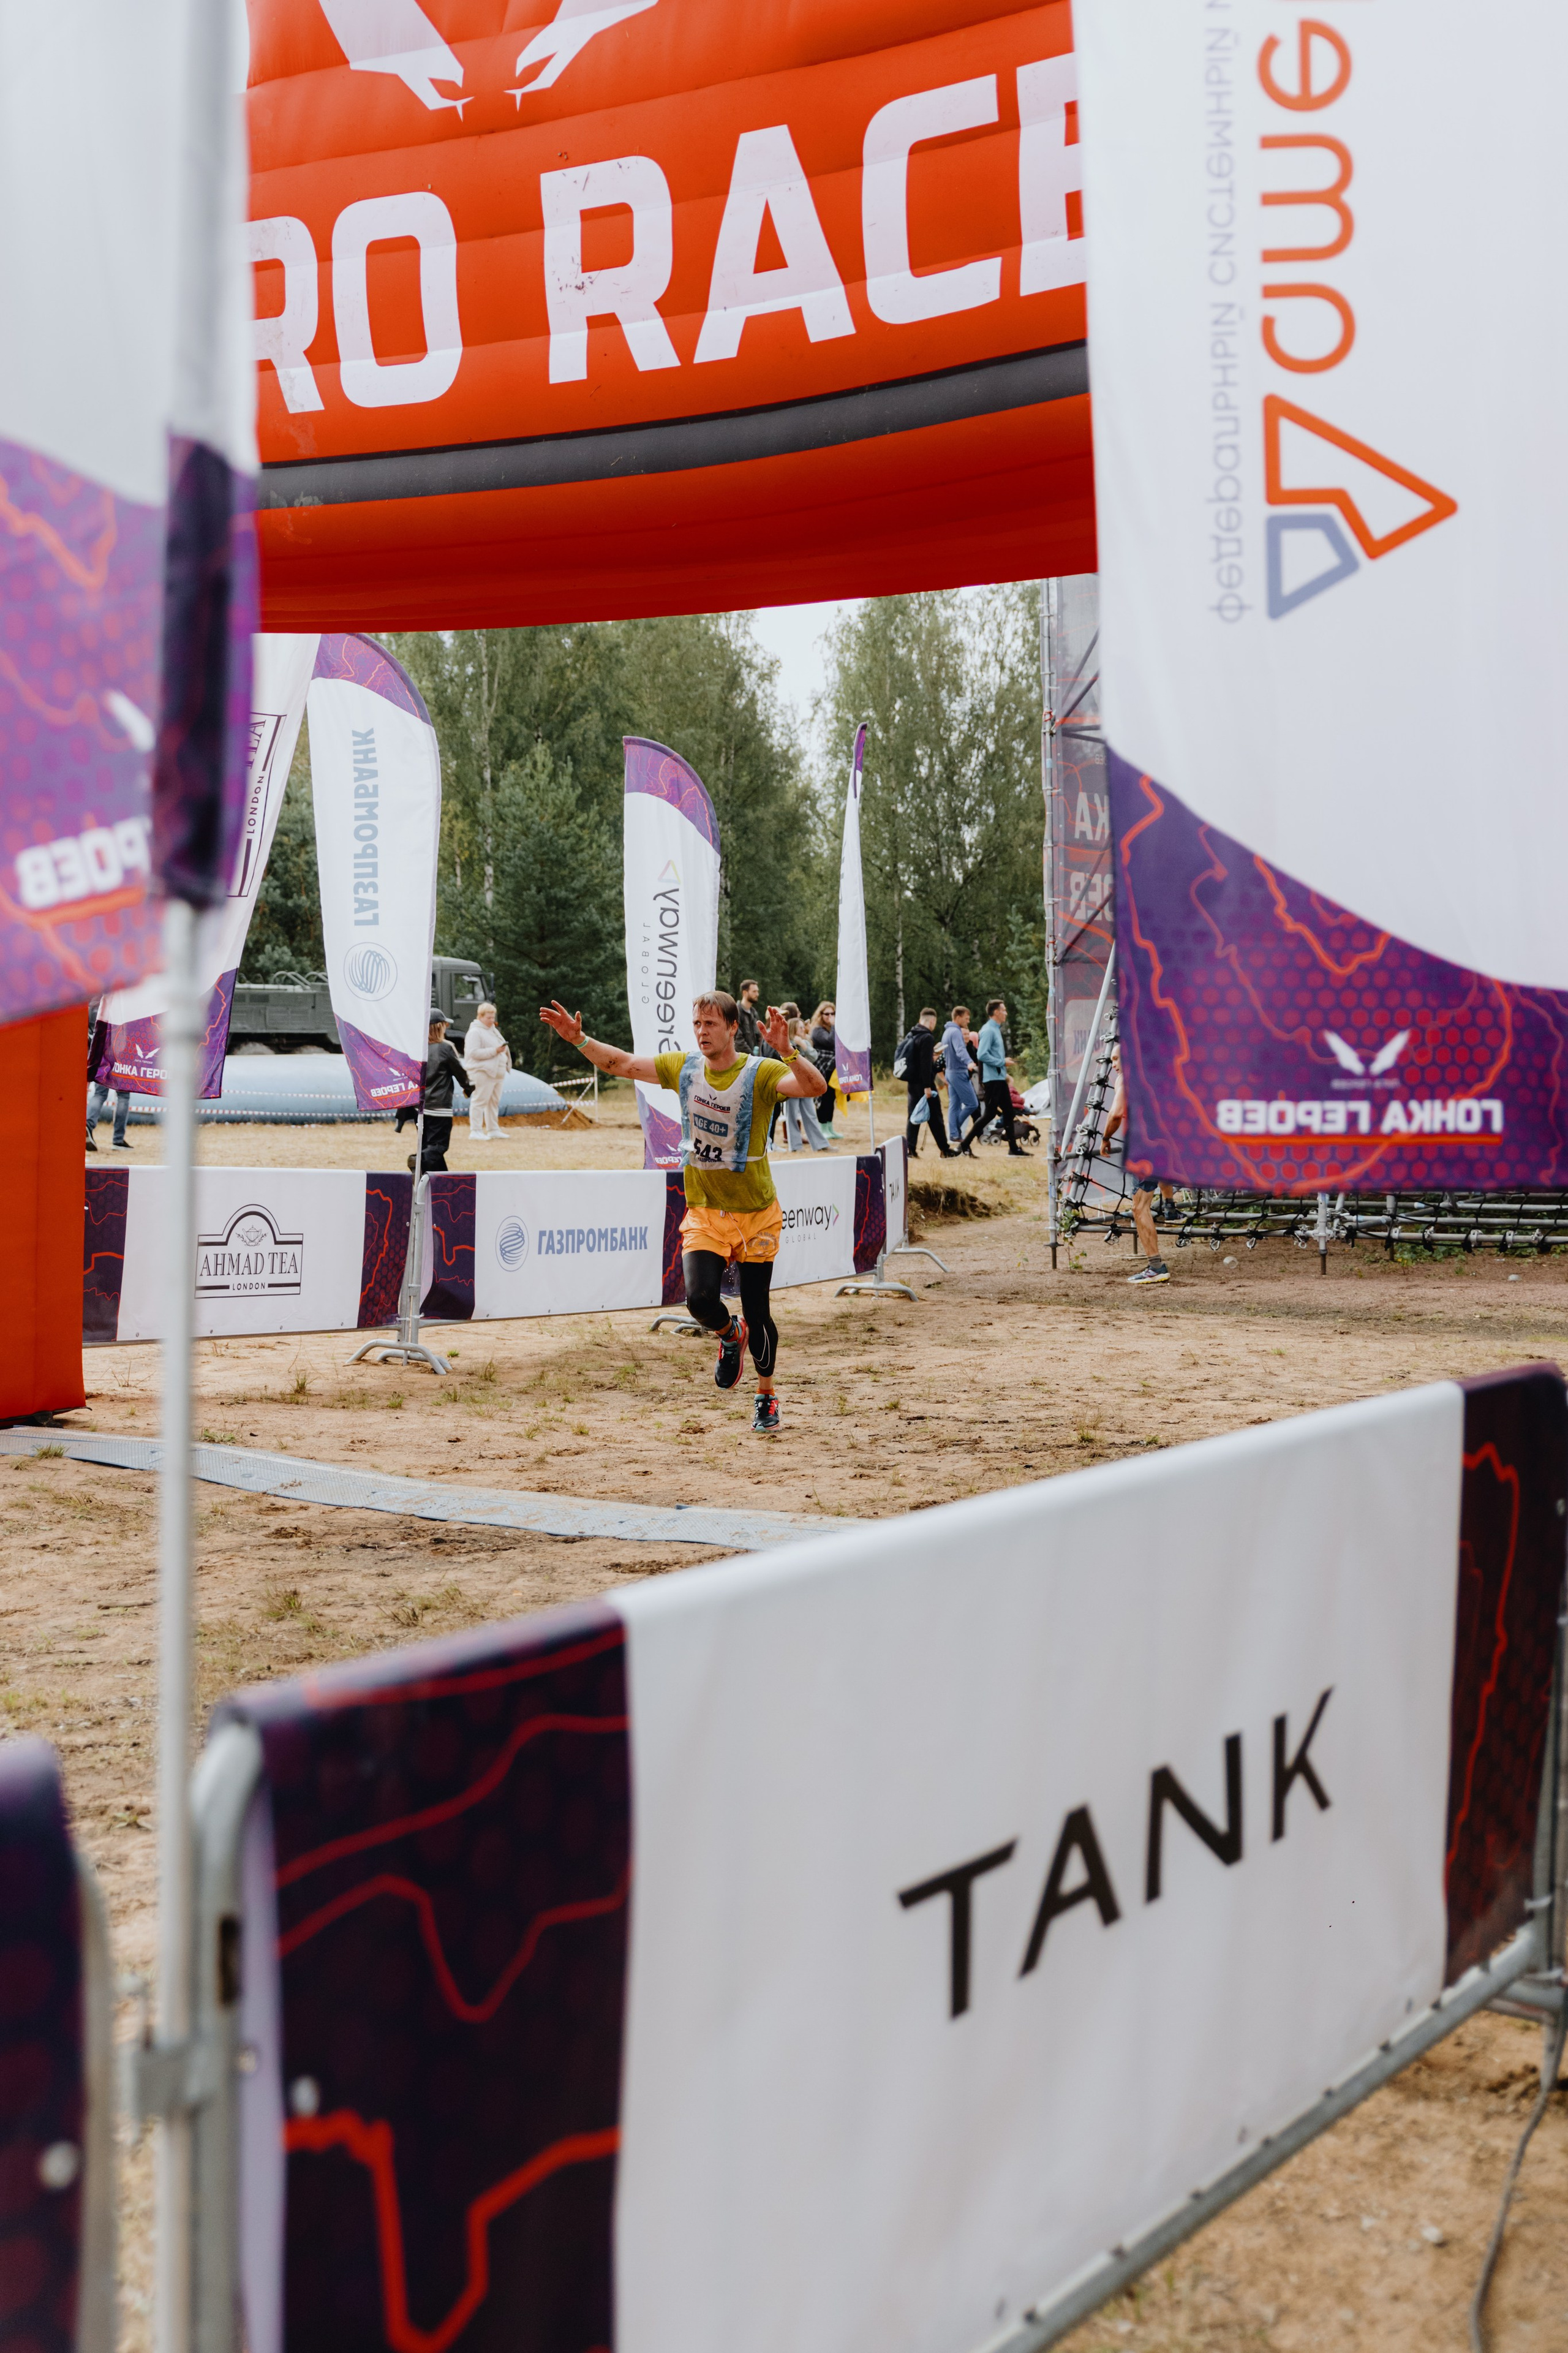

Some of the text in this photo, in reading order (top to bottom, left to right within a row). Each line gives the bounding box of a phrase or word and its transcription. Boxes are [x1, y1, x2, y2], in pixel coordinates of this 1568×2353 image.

[540, 51, 1088, 384] RACE
[246, 776, 265, 834] LONDON
[140, 1067, 172, 1079] ГЕРО
[694, 1095, 731, 1111] ГОНКА ГЕРОЕВ
[709, 1123, 726, 1133] 40+
[538, 1226, 648, 1255] ГАЗПРОМБАНК
[785, 1233, 816, 1244] GLOBAL
[199, 1252, 298, 1277] AHMAD TEA
[233, 1282, 266, 1291] LONDON
[896, 1684, 1335, 2022] TANK
